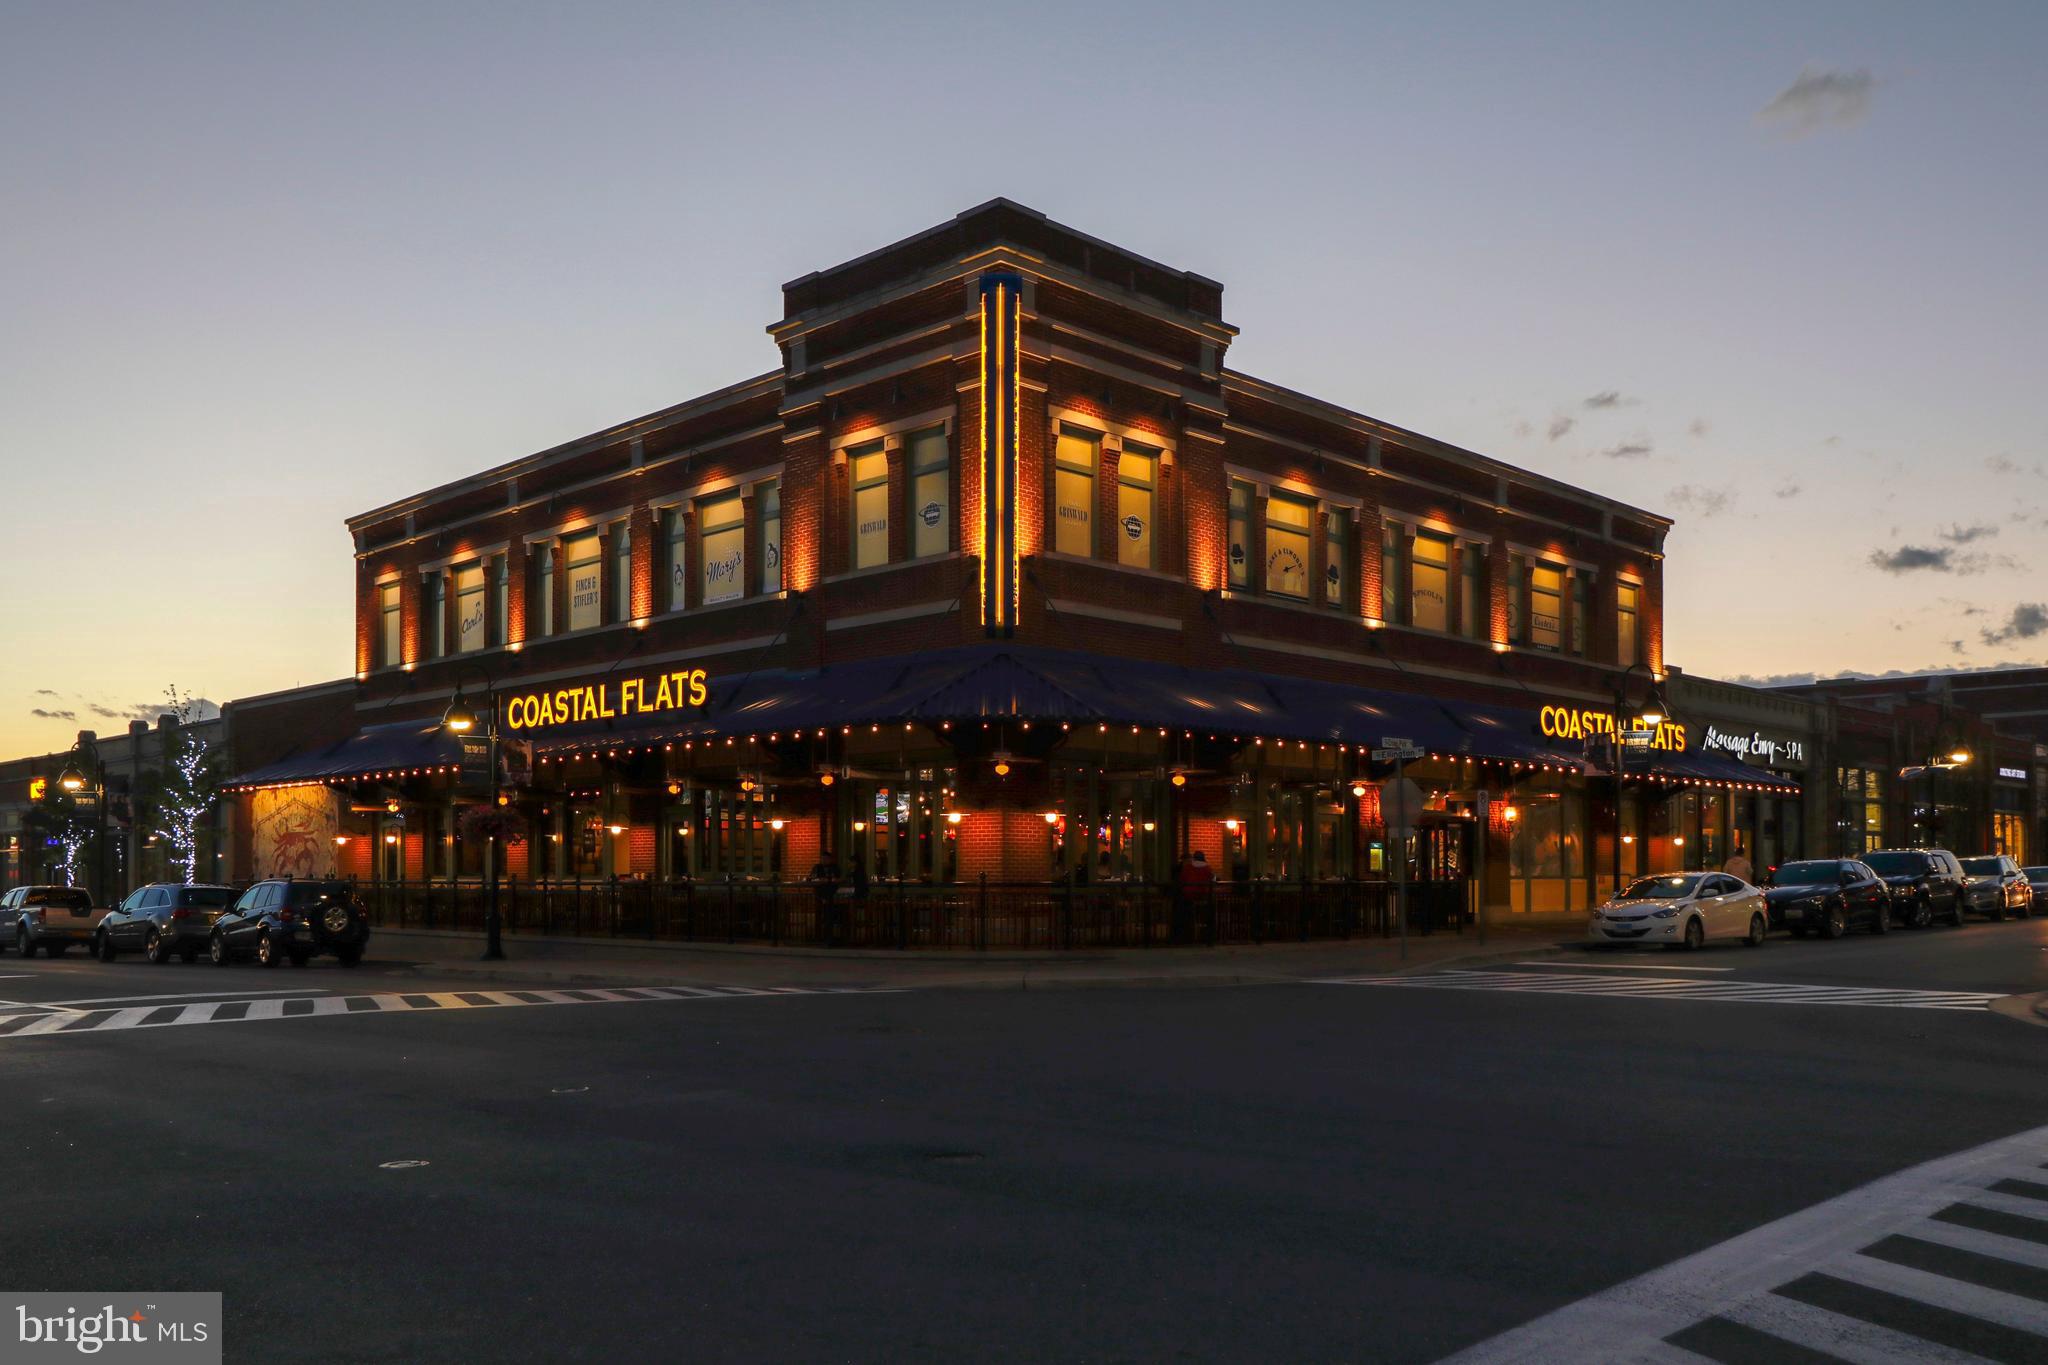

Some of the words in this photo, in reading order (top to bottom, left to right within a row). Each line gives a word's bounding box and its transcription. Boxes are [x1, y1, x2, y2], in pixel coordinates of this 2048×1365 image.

[575, 577, 592, 593] FINCH
[706, 551, 743, 585] Mary's
[508, 684, 616, 730] COASTAL
[621, 668, 708, 717] FLATS
[1381, 750, 1415, 760] Ellington
[1702, 724, 1750, 761] Massage
[1785, 741, 1803, 761] SPA
